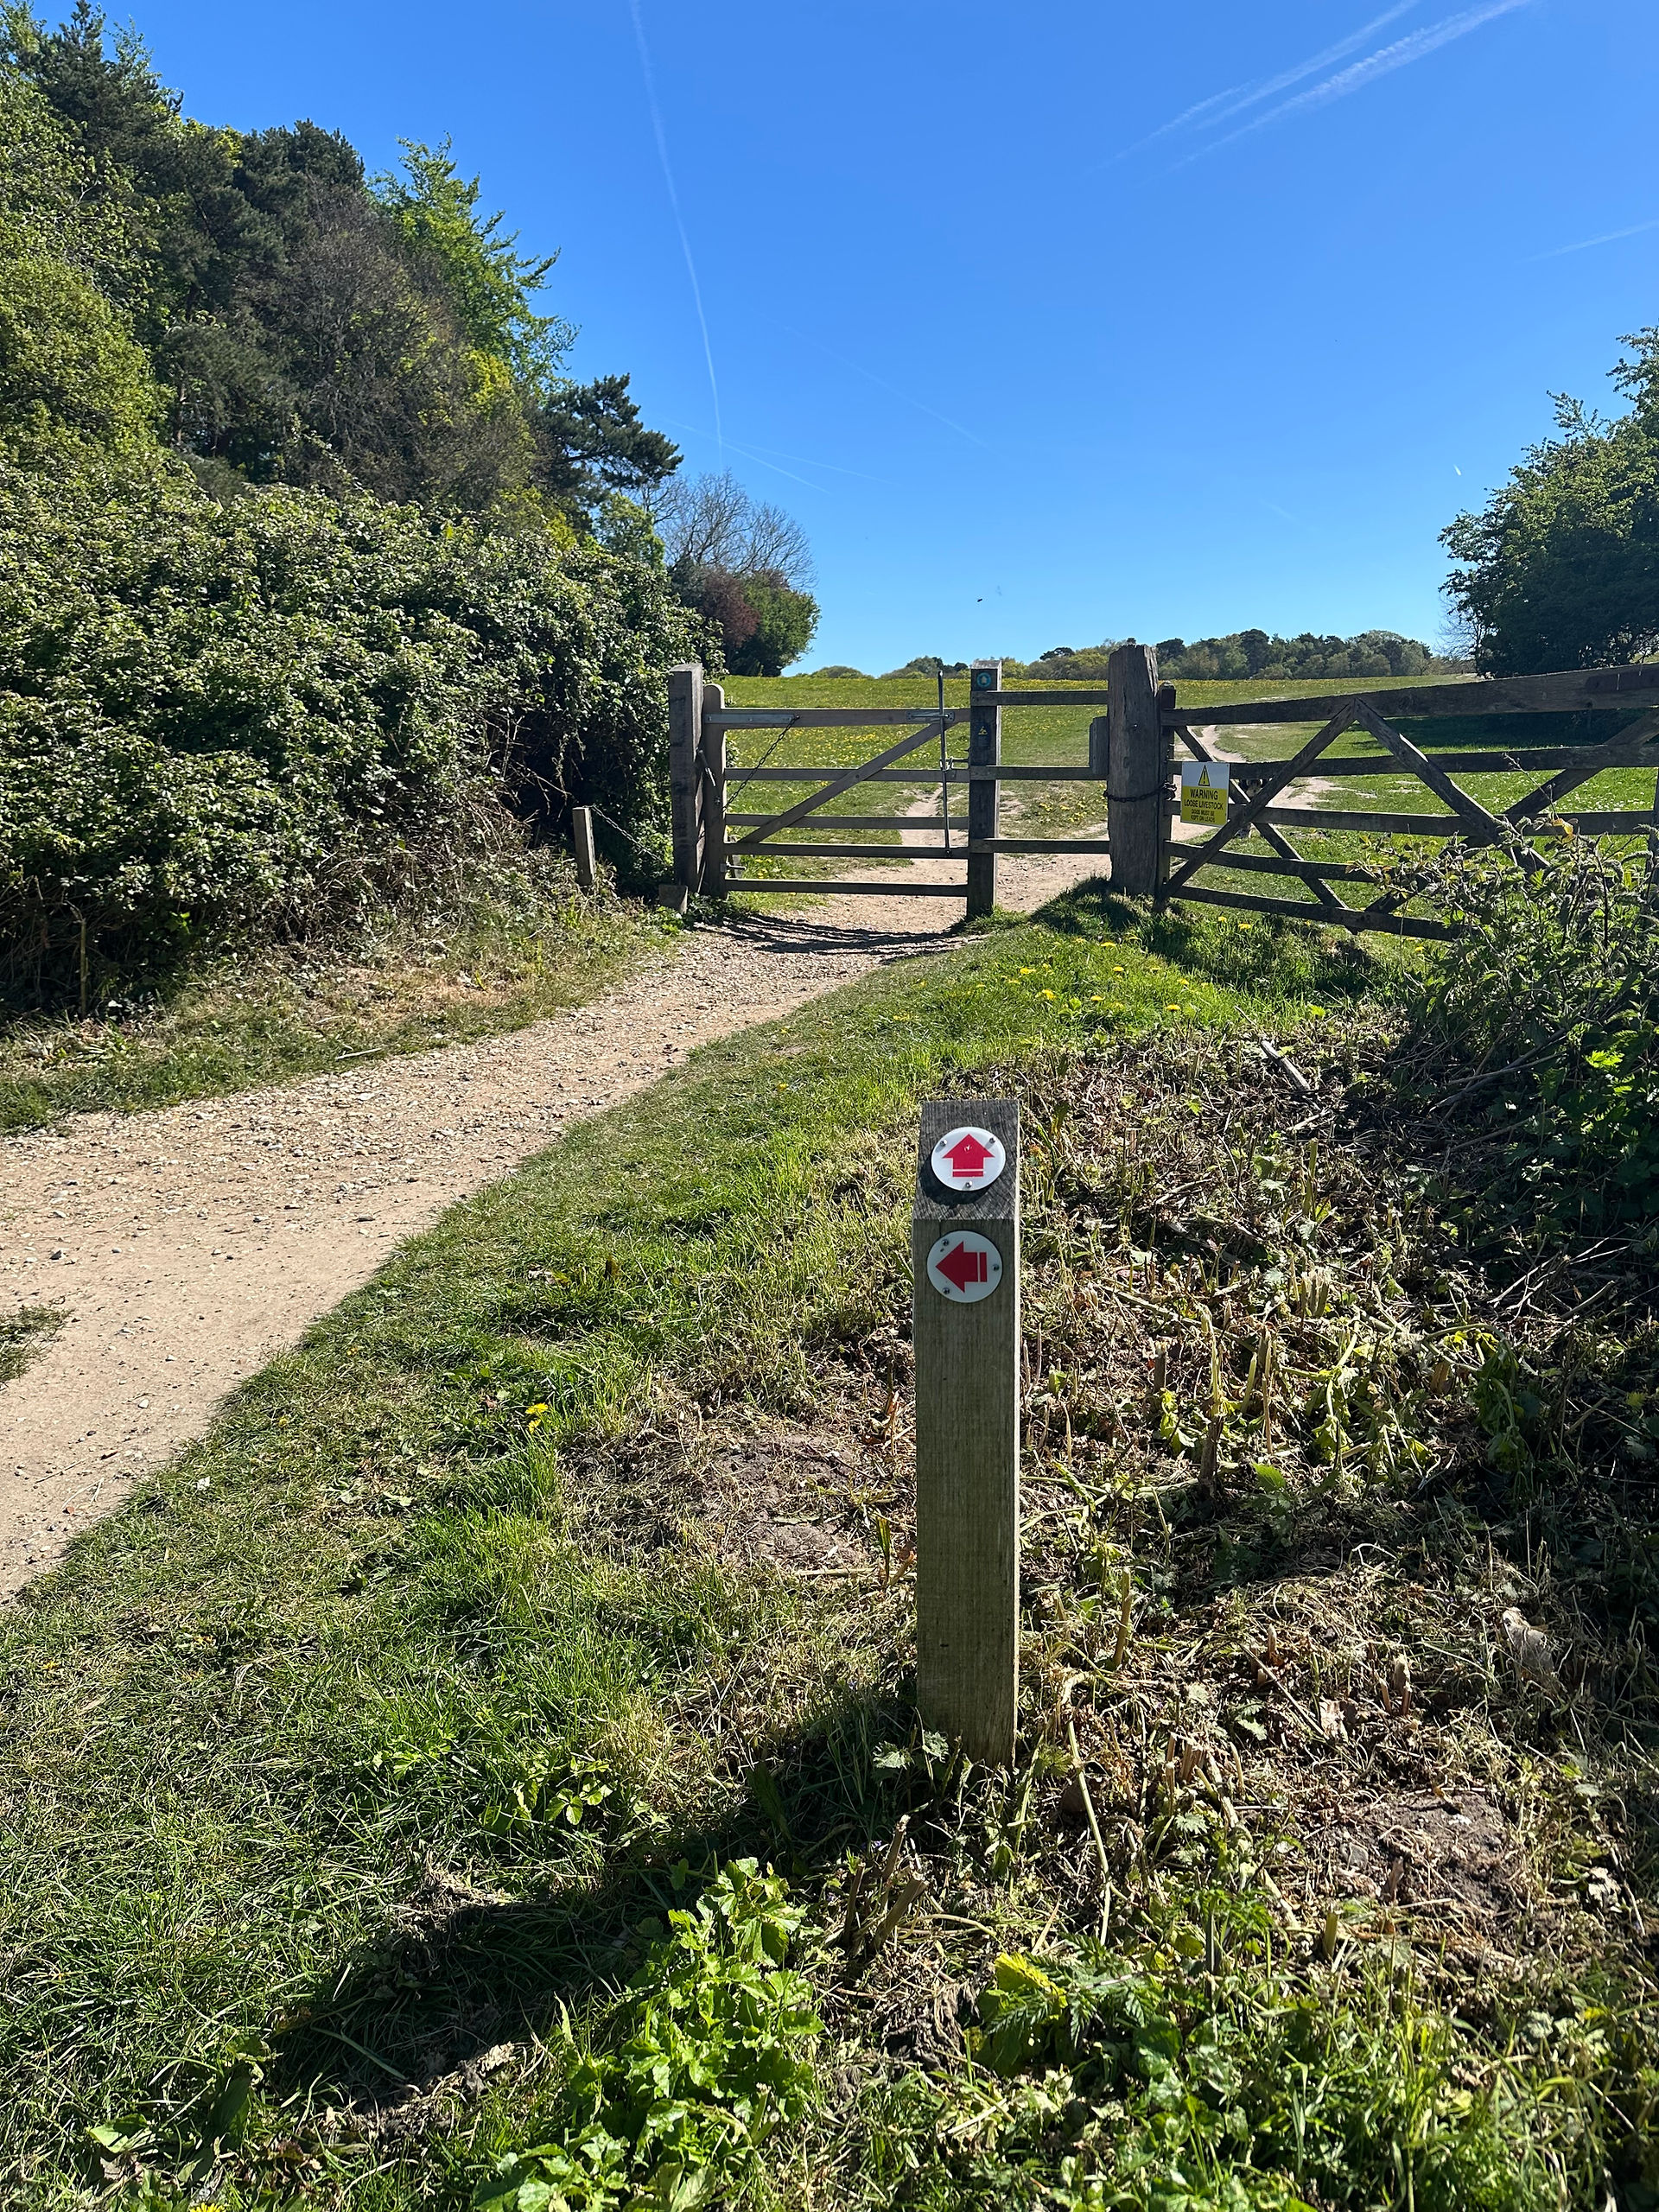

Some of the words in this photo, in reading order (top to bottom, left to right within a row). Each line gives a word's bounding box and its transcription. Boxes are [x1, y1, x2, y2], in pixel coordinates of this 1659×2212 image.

[1190, 788, 1218, 800] WARNING
[1184, 799, 1198, 807] LOOSE
[1199, 801, 1224, 810] LIVESTOCK
